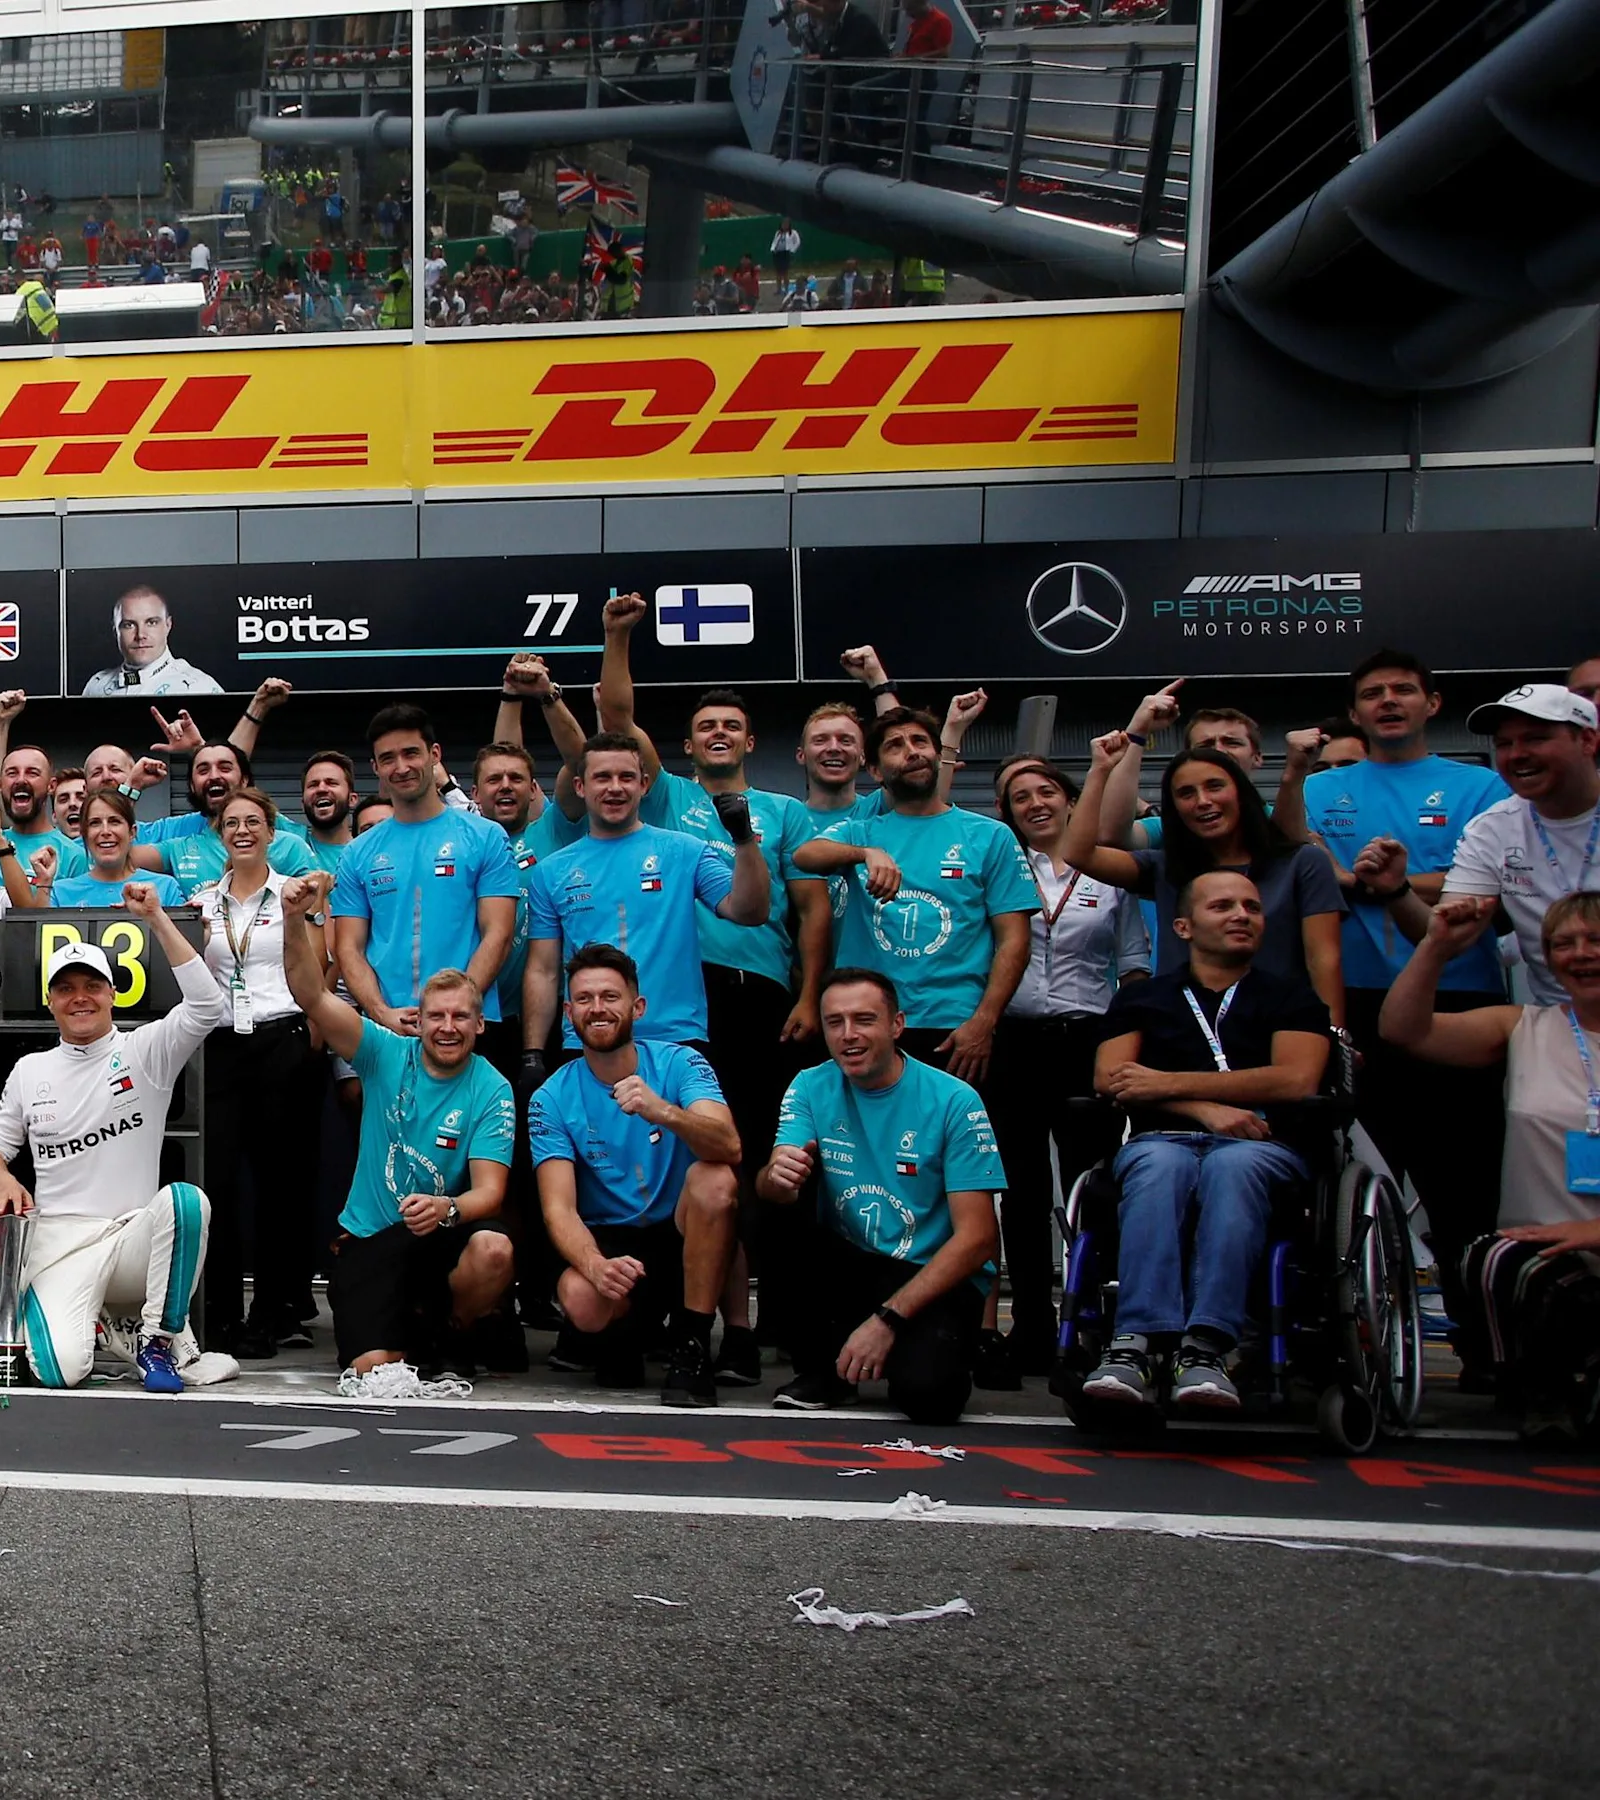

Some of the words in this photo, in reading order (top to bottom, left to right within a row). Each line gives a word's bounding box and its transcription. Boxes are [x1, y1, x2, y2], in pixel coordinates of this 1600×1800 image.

[522, 343, 1043, 462] DHL
[1247, 573, 1361, 592] AMG
[238, 593, 313, 611] Valtteri
[1153, 596, 1363, 618] PETRONAS
[524, 593, 579, 637] 77
[238, 616, 370, 644] Bottas
[1183, 619, 1364, 637] MOTORSPORT
[896, 889, 943, 908] WINNERS
[898, 903, 918, 941] 1
[894, 947, 920, 958] 2018
[37, 1112, 143, 1159] PETRONAS
[833, 1152, 853, 1163] UBS
[843, 1186, 858, 1200] GP
[859, 1202, 881, 1248] 1
[220, 1423, 519, 1456] 77
